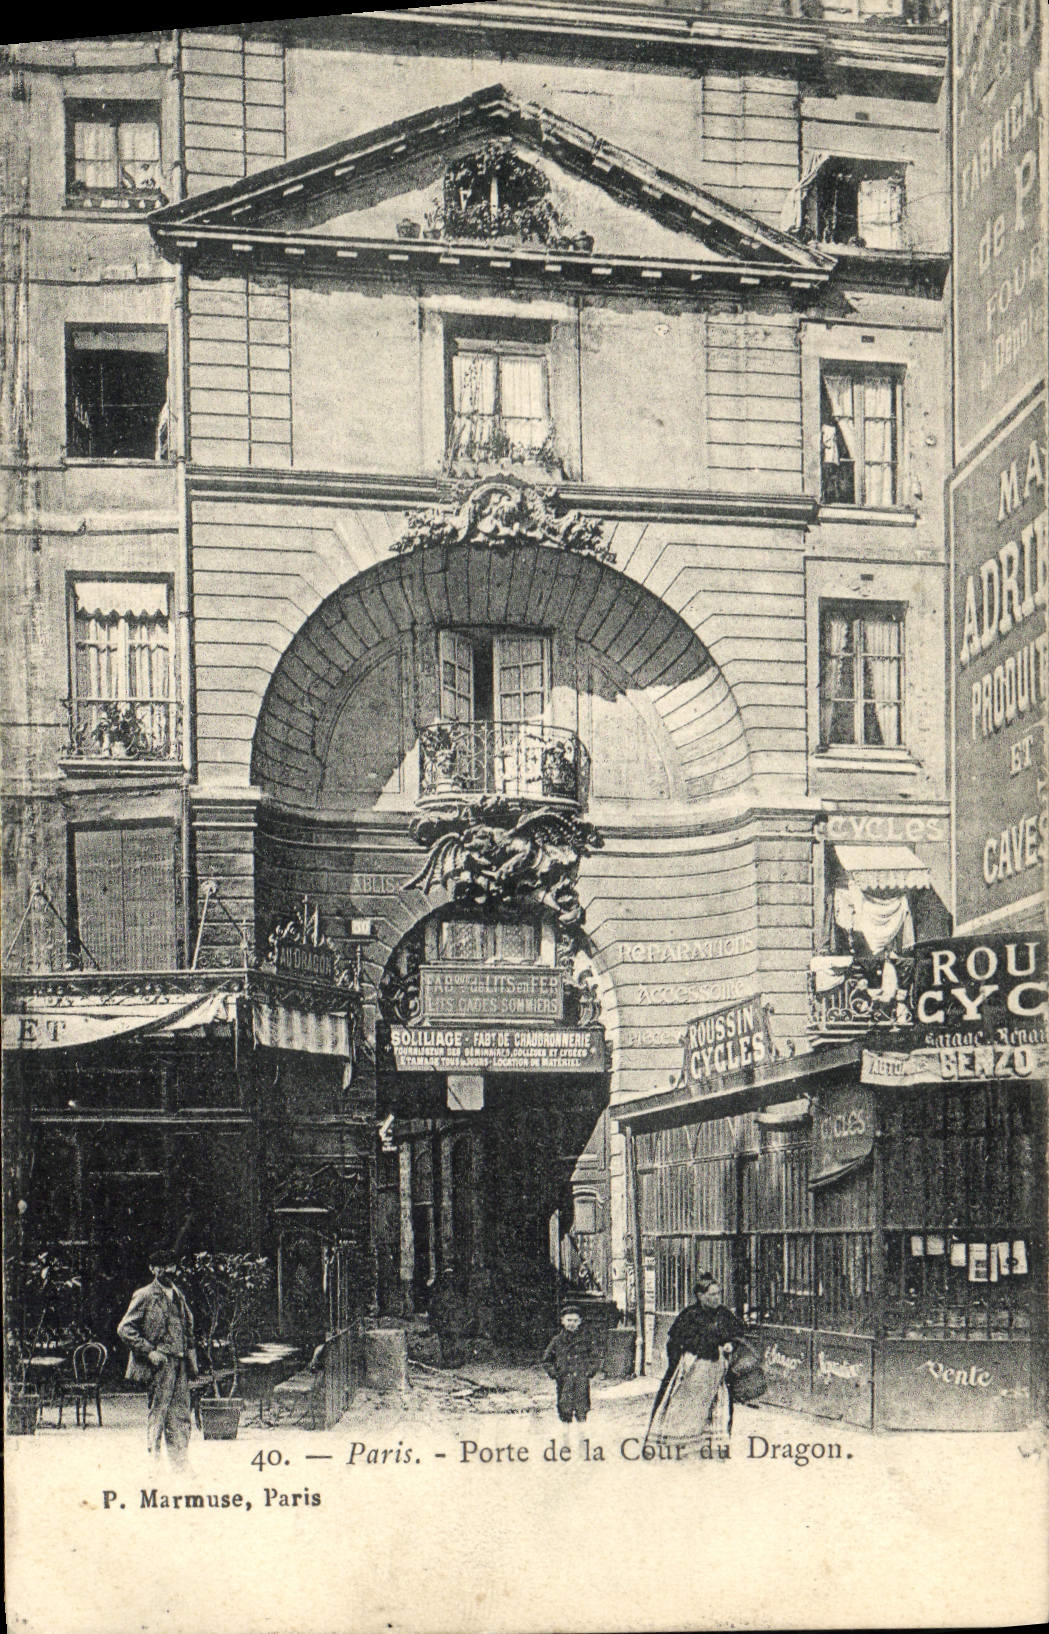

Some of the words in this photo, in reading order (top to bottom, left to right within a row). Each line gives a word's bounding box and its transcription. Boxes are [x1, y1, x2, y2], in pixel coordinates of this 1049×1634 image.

[1010, 736, 1034, 775] ET
[486, 975, 516, 993] LITS
[531, 975, 559, 993] FER
[497, 1032, 510, 1047] DE
[689, 1007, 754, 1049] ROUSSIN
[690, 1032, 766, 1079] CYCLES
